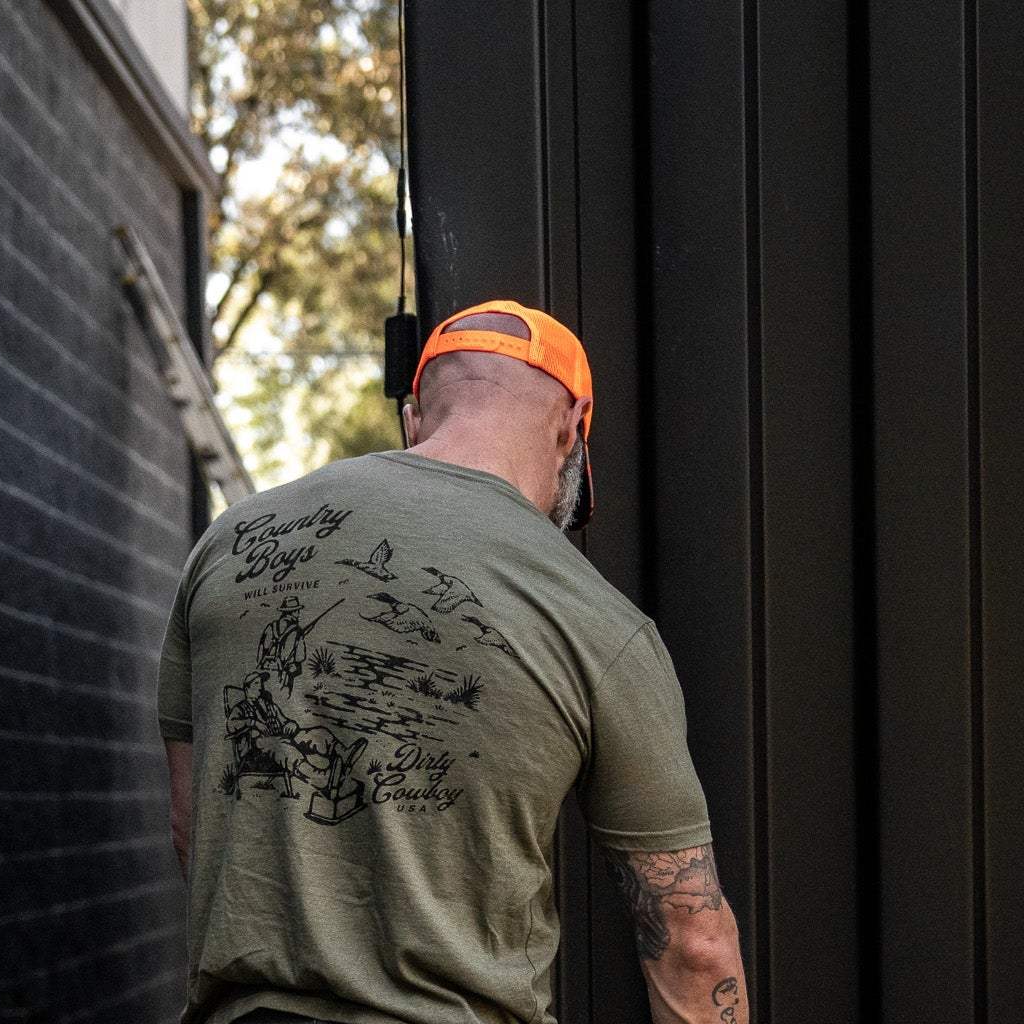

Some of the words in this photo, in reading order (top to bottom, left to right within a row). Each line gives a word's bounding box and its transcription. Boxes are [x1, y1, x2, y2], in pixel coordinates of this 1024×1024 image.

[232, 503, 354, 555] Country
[235, 540, 318, 583] Boys
[244, 588, 268, 600] WILL
[272, 580, 320, 594] SURVIVE
[386, 743, 457, 781] Dirty
[372, 773, 464, 811] Cowboy
[397, 804, 427, 812] USA
